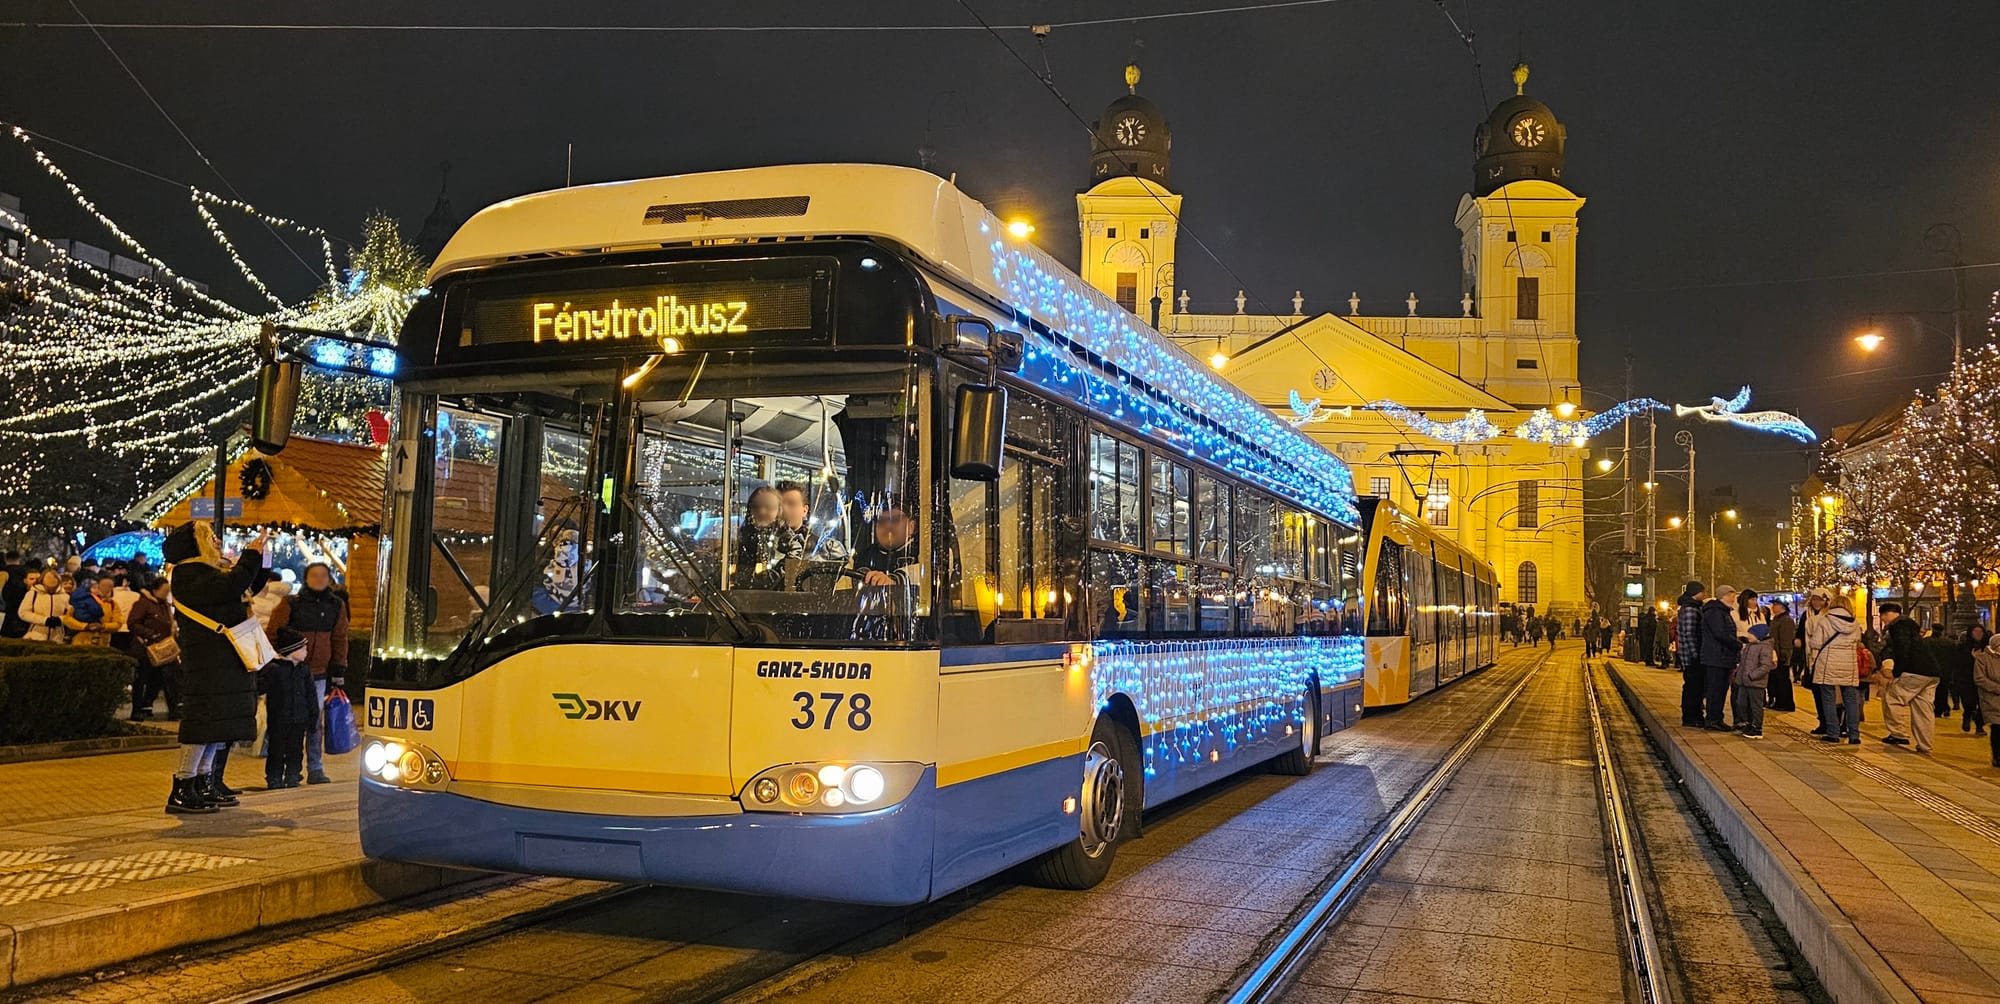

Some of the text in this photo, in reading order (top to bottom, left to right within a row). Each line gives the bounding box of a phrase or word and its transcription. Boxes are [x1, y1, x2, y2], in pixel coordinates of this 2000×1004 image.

[533, 295, 748, 342] Fénytrolibusz
[757, 660, 872, 679] GANZ-ŠKODA
[585, 699, 642, 721] DKV
[791, 691, 872, 731] 378
